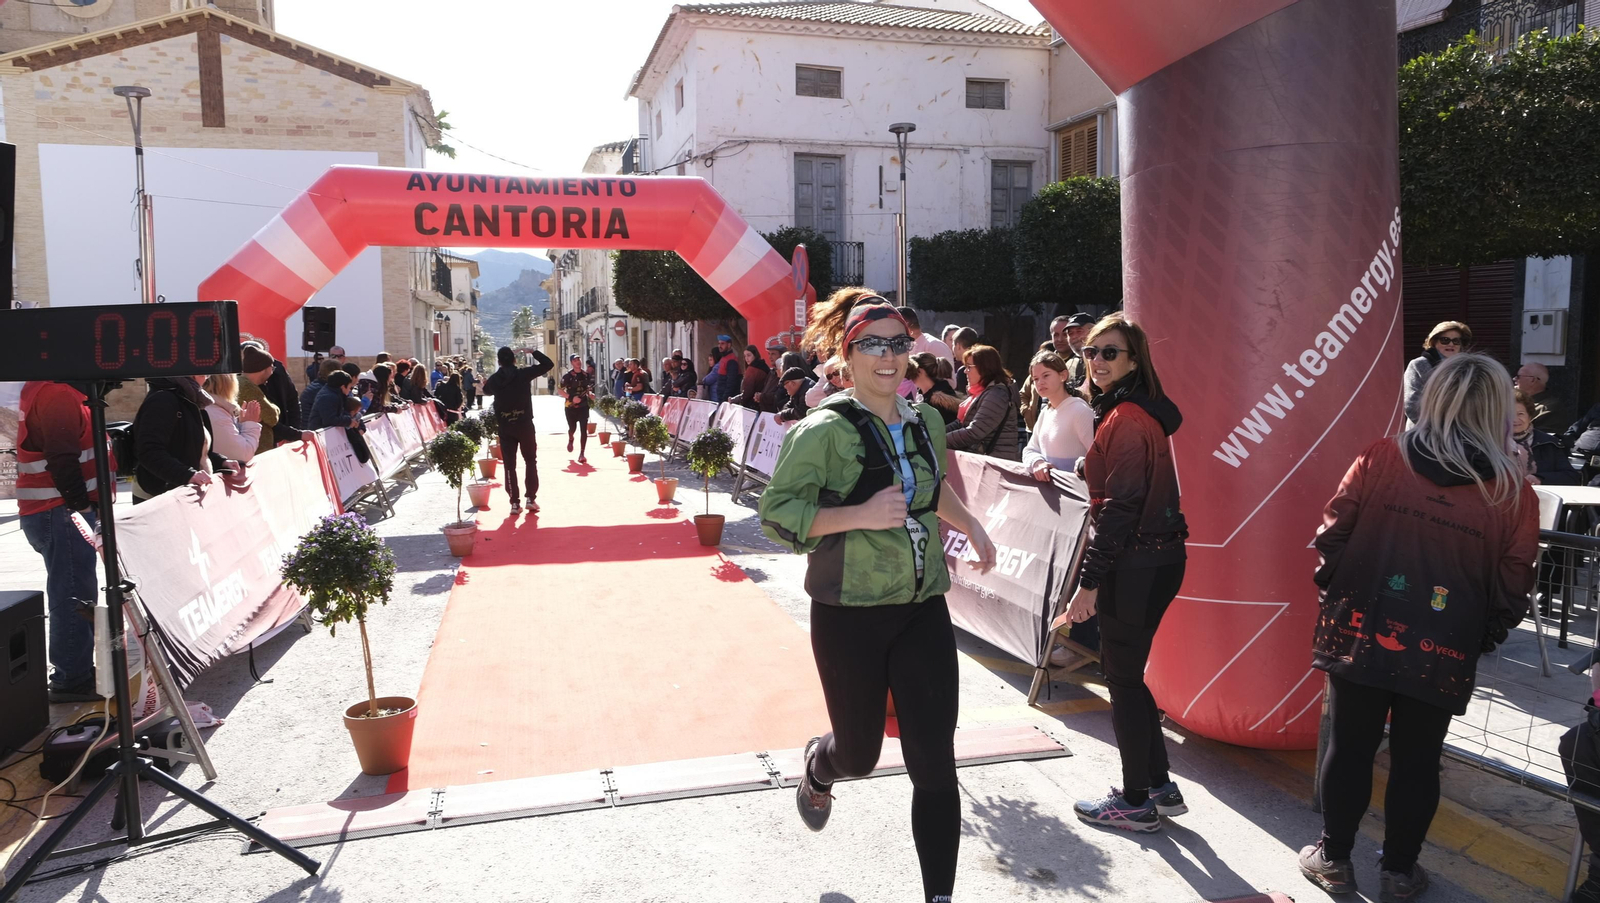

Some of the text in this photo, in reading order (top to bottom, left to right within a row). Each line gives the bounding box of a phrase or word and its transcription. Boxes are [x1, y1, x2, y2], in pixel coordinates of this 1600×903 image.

[406, 172, 637, 198] AYUNTAMIENTO
[414, 202, 630, 239] CANTORIA
[1212, 205, 1402, 469] www.teamergy.es
[1383, 503, 1409, 515] VALLE
[1412, 509, 1426, 519] DE
[944, 529, 1037, 579] TEARGY
